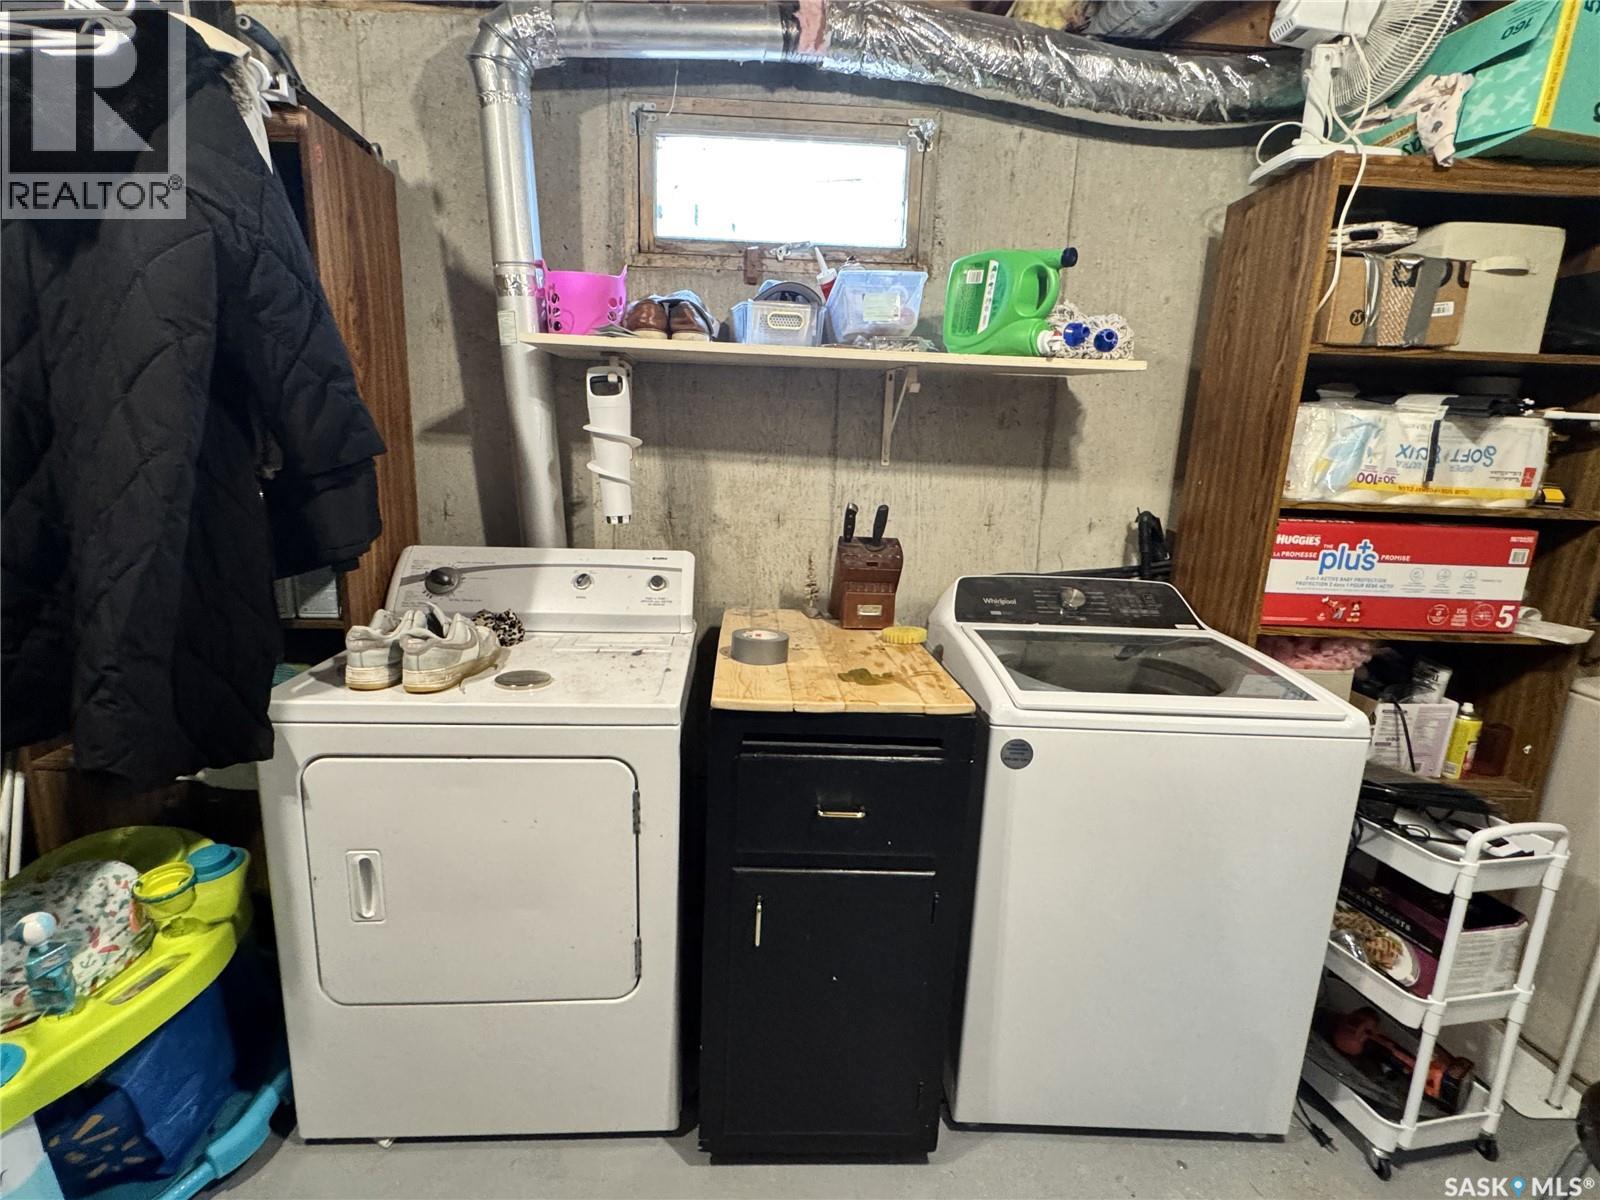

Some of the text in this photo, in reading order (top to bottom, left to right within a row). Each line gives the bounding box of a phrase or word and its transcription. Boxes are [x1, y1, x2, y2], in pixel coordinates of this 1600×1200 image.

[1500, 16, 1534, 40] 160
[1449, 445, 1497, 467] SOFT
[1275, 533, 1321, 546] HUGGIES
[1281, 550, 1318, 558] PROMESSE
[1380, 554, 1411, 562] PROMISE
[1495, 604, 1516, 628] 5
